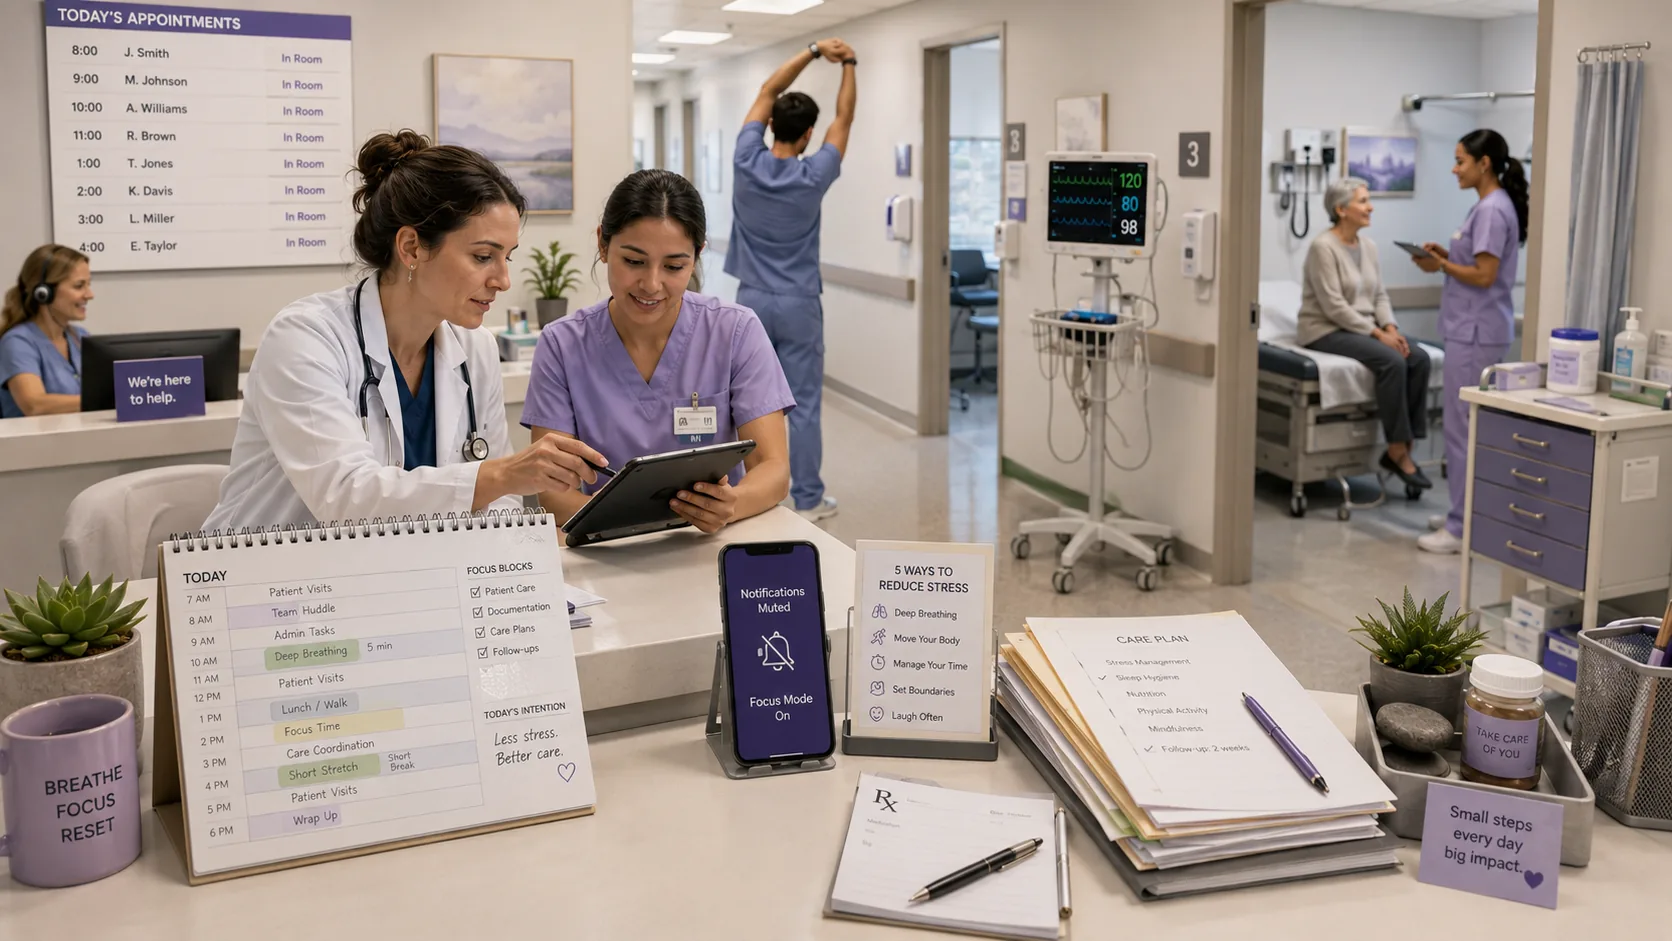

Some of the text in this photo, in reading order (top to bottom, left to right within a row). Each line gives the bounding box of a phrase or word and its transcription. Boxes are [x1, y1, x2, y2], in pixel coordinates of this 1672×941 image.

[58, 8, 241, 29] TODAY'S APPOINTMENTS
[72, 45, 322, 64] 8:00 J. Smith In Room
[73, 74, 187, 87] 9:00 M. Johnson
[72, 102, 187, 114] 10:00 A. Williams
[73, 131, 176, 141] 11:00 R. Brown
[1187, 141, 1199, 167] 3
[77, 159, 173, 168] 1:00 T. Jones
[1120, 173, 1142, 188] 120
[77, 186, 173, 197] 2:00 K. Davis
[1122, 196, 1138, 212] 80
[78, 214, 174, 224] 3:00 L. Miller
[1121, 220, 1137, 235] 98
[80, 241, 177, 252] 4:00 E. Taylor
[128, 375, 191, 388] We're here
[130, 391, 176, 405] to help.
[467, 562, 533, 574] FOCUS BLOCKS
[895, 566, 953, 576] 5 WAYS TO
[183, 571, 227, 583] TODAY
[269, 584, 332, 597] Patient Visits
[485, 584, 535, 596] Patient Care
[879, 580, 968, 593] REDUCE STRESS
[196, 595, 210, 603] AM
[741, 587, 805, 599] Notifications
[272, 604, 335, 618] Team Huddle
[488, 603, 550, 616] Documentation
[758, 603, 790, 612] Muted
[198, 616, 212, 624] AM
[895, 609, 957, 620] Deep Breathing
[274, 627, 335, 640] Admin Tasks
[491, 624, 535, 636] Care Plans
[191, 637, 214, 646] 9 AM
[894, 635, 960, 646] Move Your Body
[1117, 635, 1189, 644] CARE PLAN
[367, 642, 392, 652] 5 min
[493, 645, 539, 657] Follow-ups
[275, 647, 347, 662] Deep Breathing
[894, 660, 968, 671] Manage Your Time
[204, 675, 219, 683] AM
[279, 674, 344, 688] Patient Visits
[893, 685, 955, 696] Set Boundaries
[207, 693, 221, 701] PM
[750, 694, 813, 707] Focus Mode
[282, 703, 311, 715] Lunch
[324, 699, 347, 709] Walk
[484, 703, 566, 719] TODAY'S INTENTION
[207, 714, 221, 722] PM
[775, 711, 790, 721] On
[892, 711, 943, 722] Laugh Often
[285, 722, 340, 736] Focus Time
[1476, 726, 1528, 744] TAKE CARE
[201, 736, 224, 746] 2 PM
[494, 728, 558, 746] Less stress.
[287, 740, 374, 759] Care Coordination
[1483, 743, 1520, 759] OF YOU
[203, 758, 226, 768] 3 PM
[388, 752, 411, 762] Short
[495, 748, 563, 766] Better care.
[289, 763, 358, 781] Short Stretch
[391, 762, 415, 771] Break
[45, 765, 122, 795] BREATHE
[205, 780, 229, 790] 4 PM
[292, 786, 357, 803] Patient Visits
[57, 793, 115, 818] FOCUS
[208, 803, 231, 814] 5 PM
[293, 811, 337, 827] Wrap Up
[1451, 806, 1533, 833] Small steps
[62, 817, 115, 843] RESET
[210, 826, 233, 837] 6 PM
[1454, 829, 1523, 854] every day
[1445, 846, 1523, 873] big impact.
